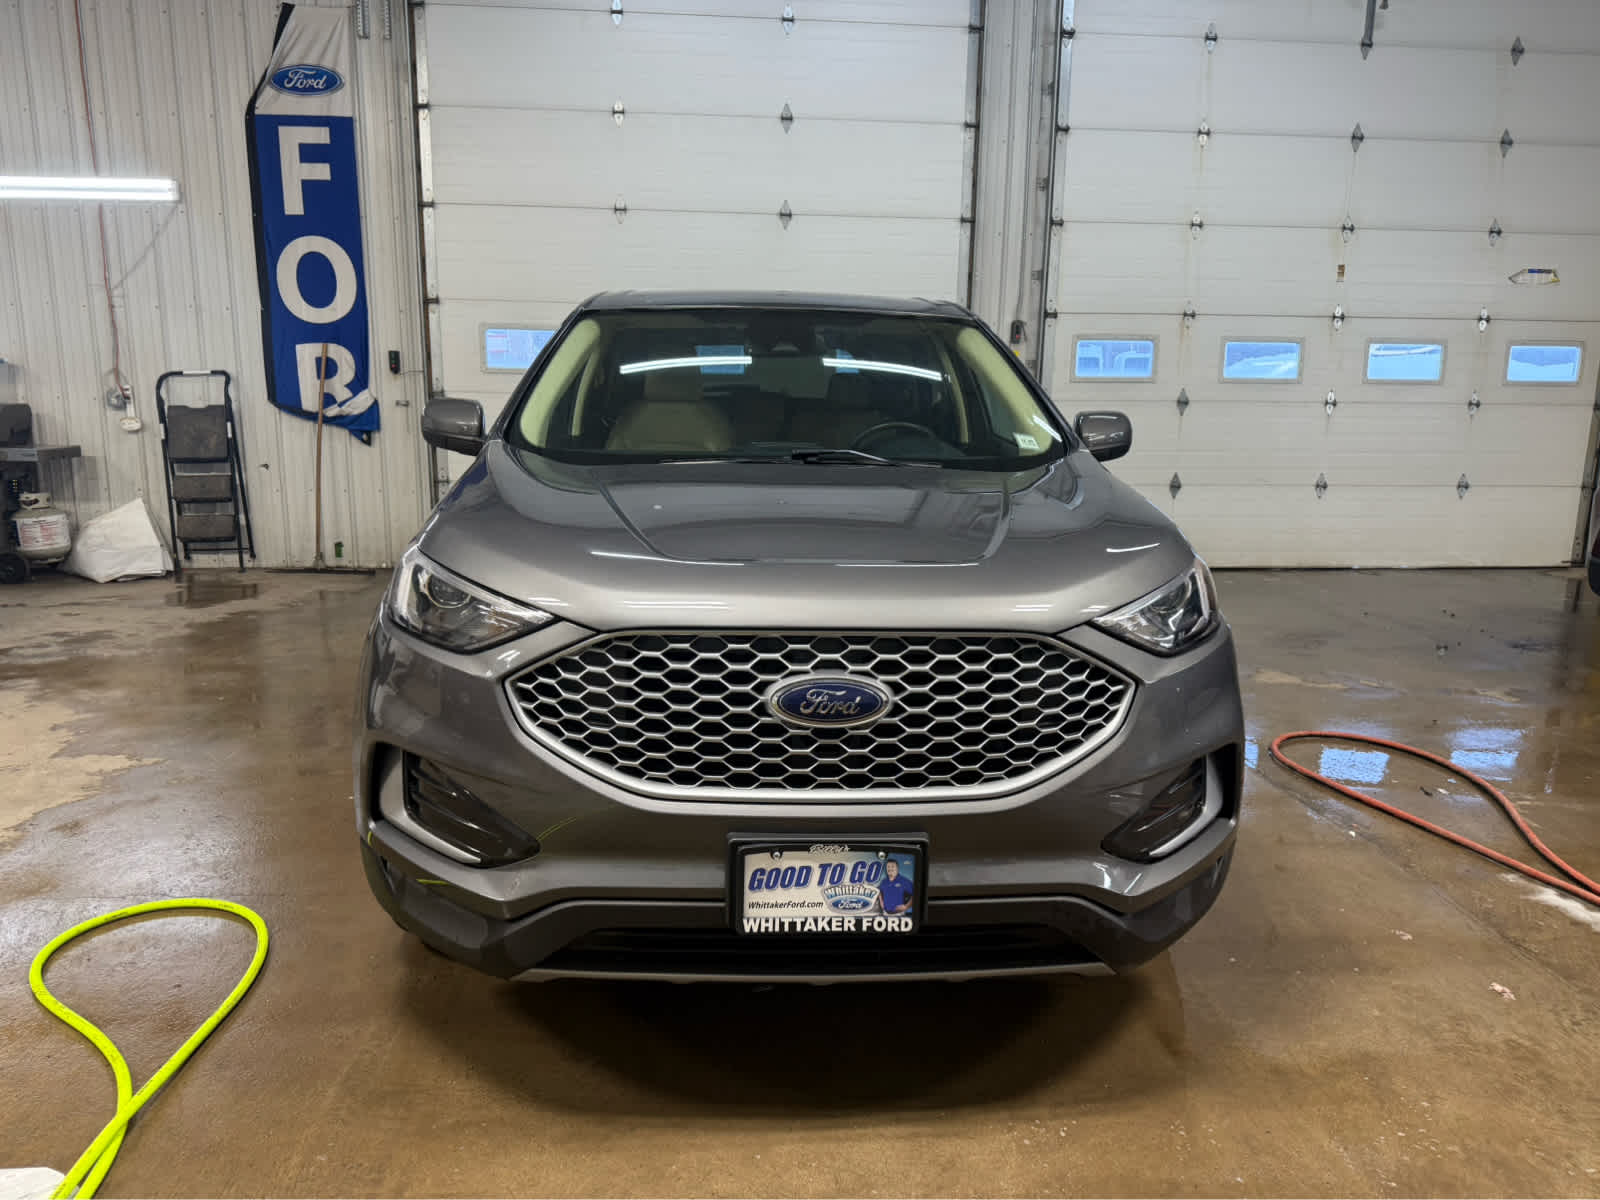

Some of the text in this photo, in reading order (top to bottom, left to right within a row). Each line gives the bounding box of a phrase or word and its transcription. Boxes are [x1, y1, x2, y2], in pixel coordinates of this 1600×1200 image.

[284, 69, 327, 89] Ford
[800, 688, 862, 715] Ford
[748, 861, 883, 892] GOOD TO GO
[748, 901, 824, 909] WhittakerFord.com
[743, 917, 913, 933] WHITTAKER FORD
